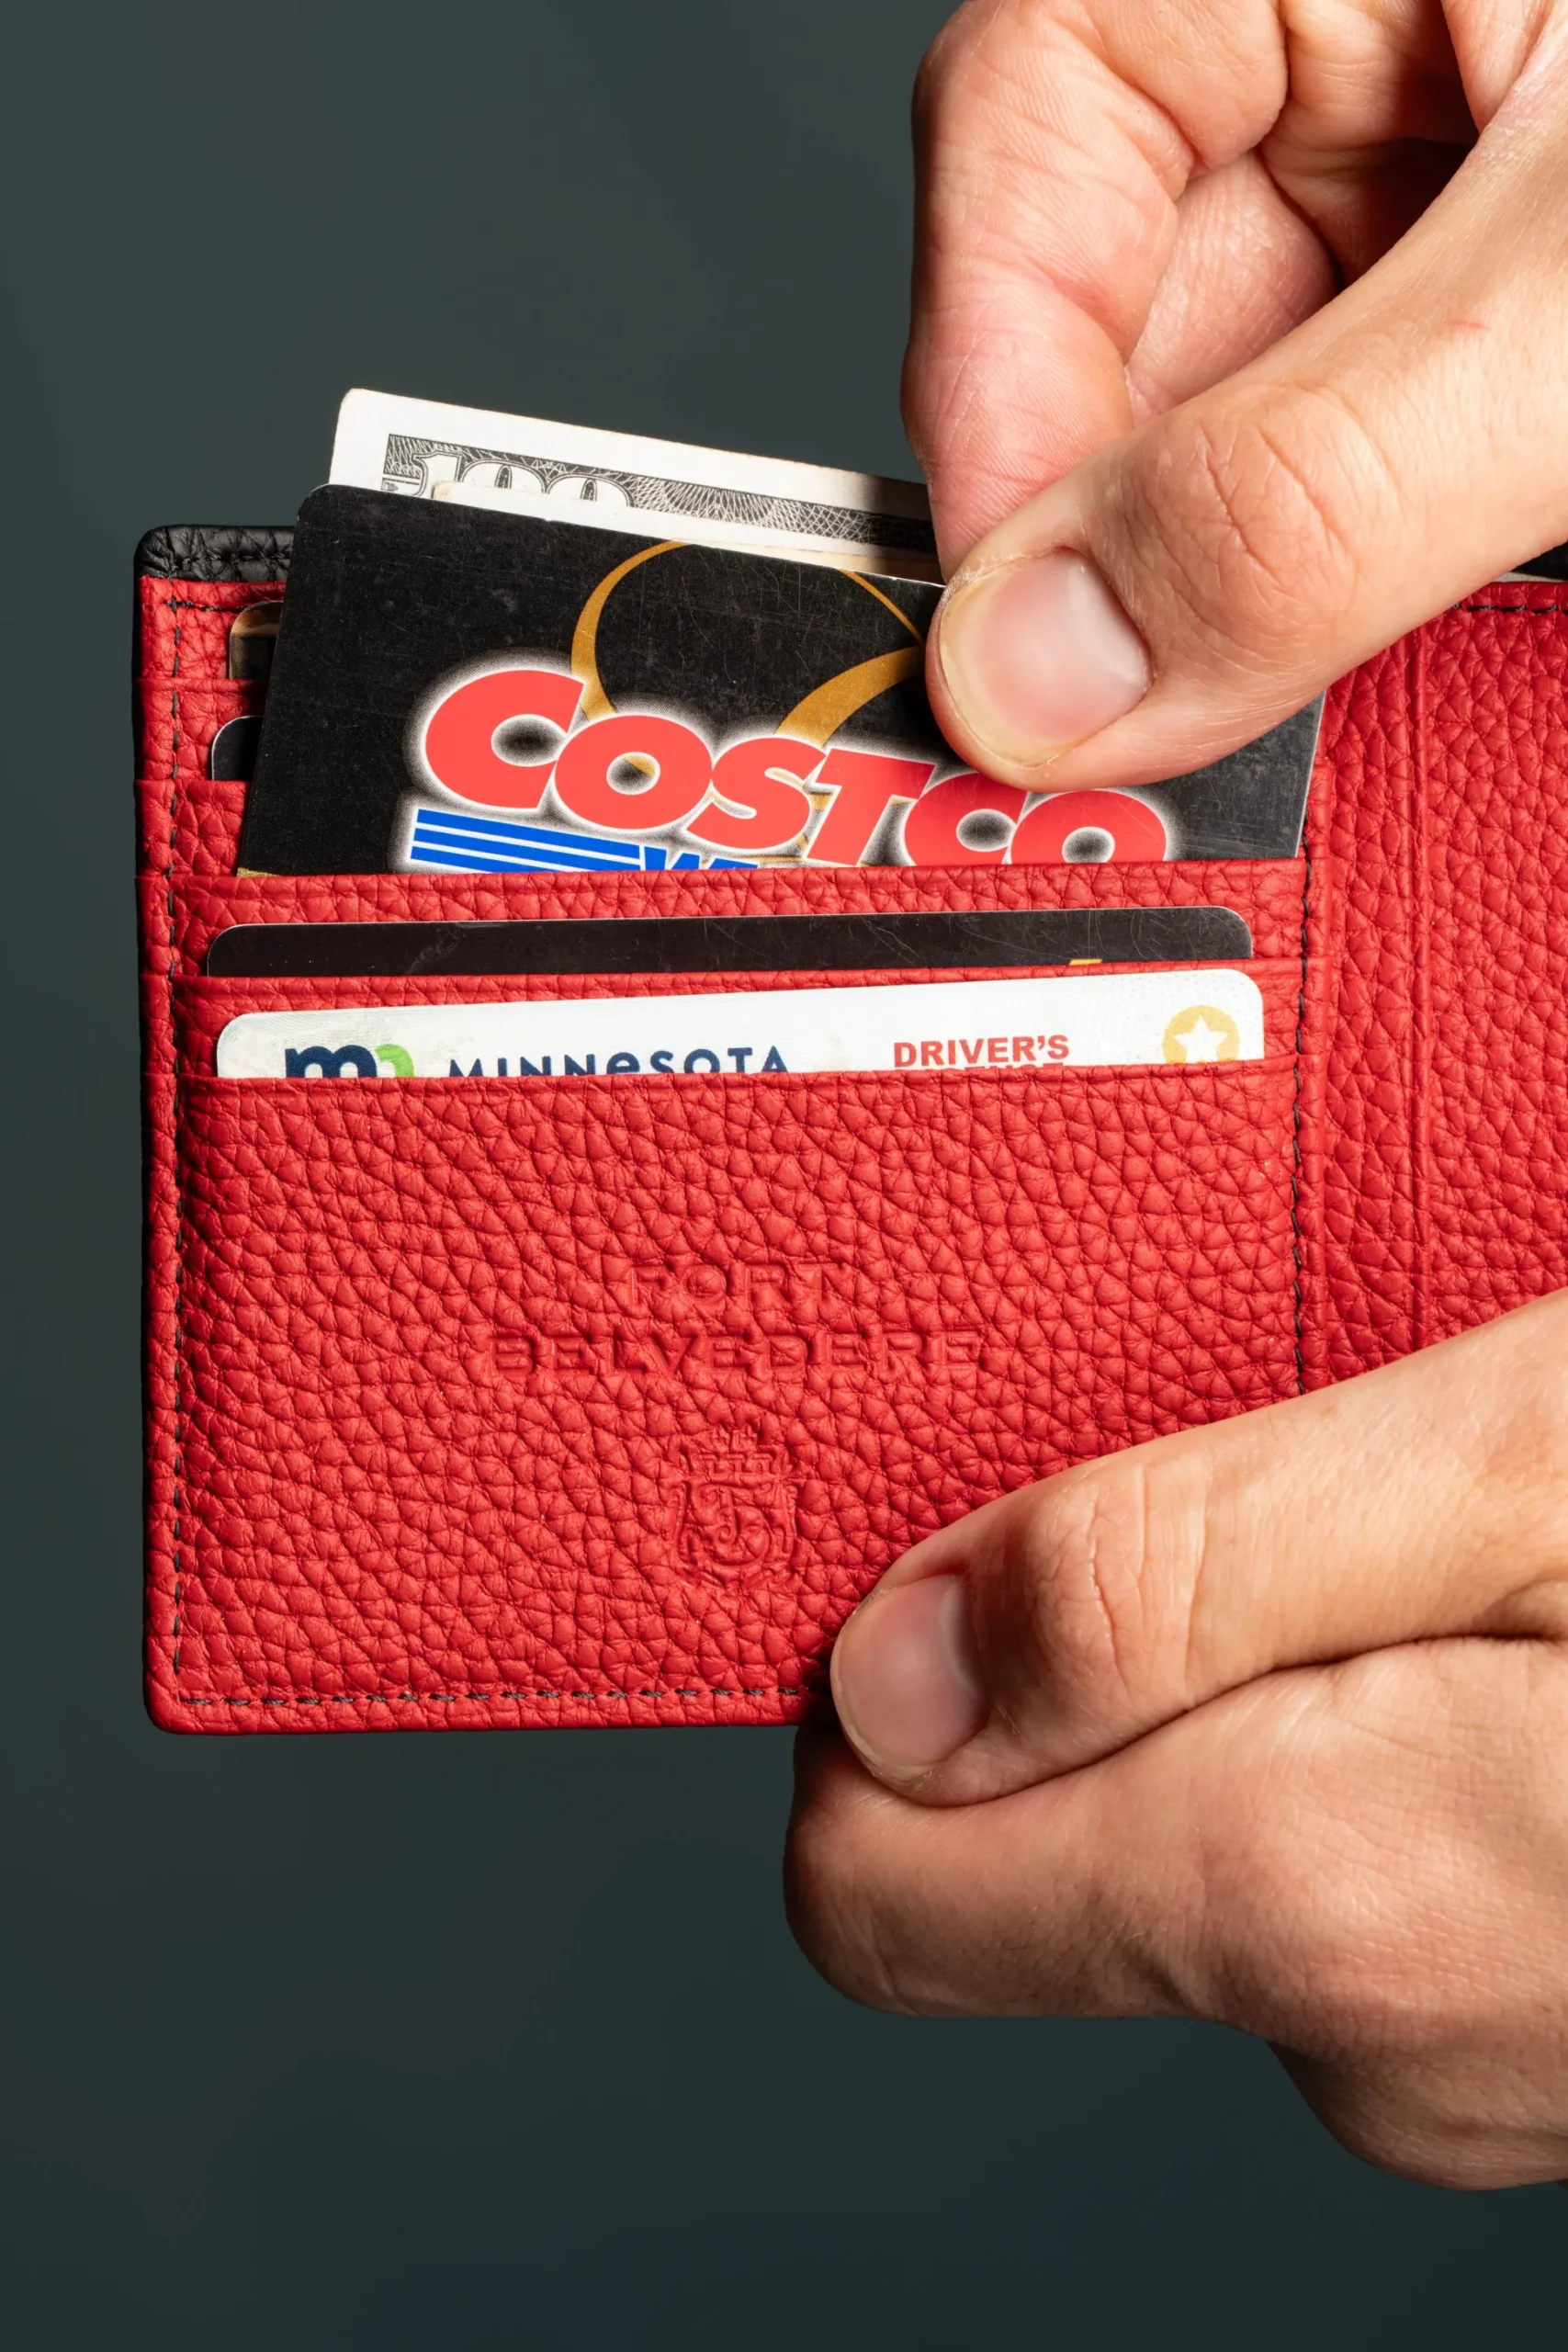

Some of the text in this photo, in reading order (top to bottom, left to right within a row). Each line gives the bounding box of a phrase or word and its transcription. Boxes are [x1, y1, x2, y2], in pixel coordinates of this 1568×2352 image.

[423, 668, 1167, 866] COSTCO
[626, 1262, 840, 1306] FORT
[490, 1330, 981, 1378] BELVEDERE
